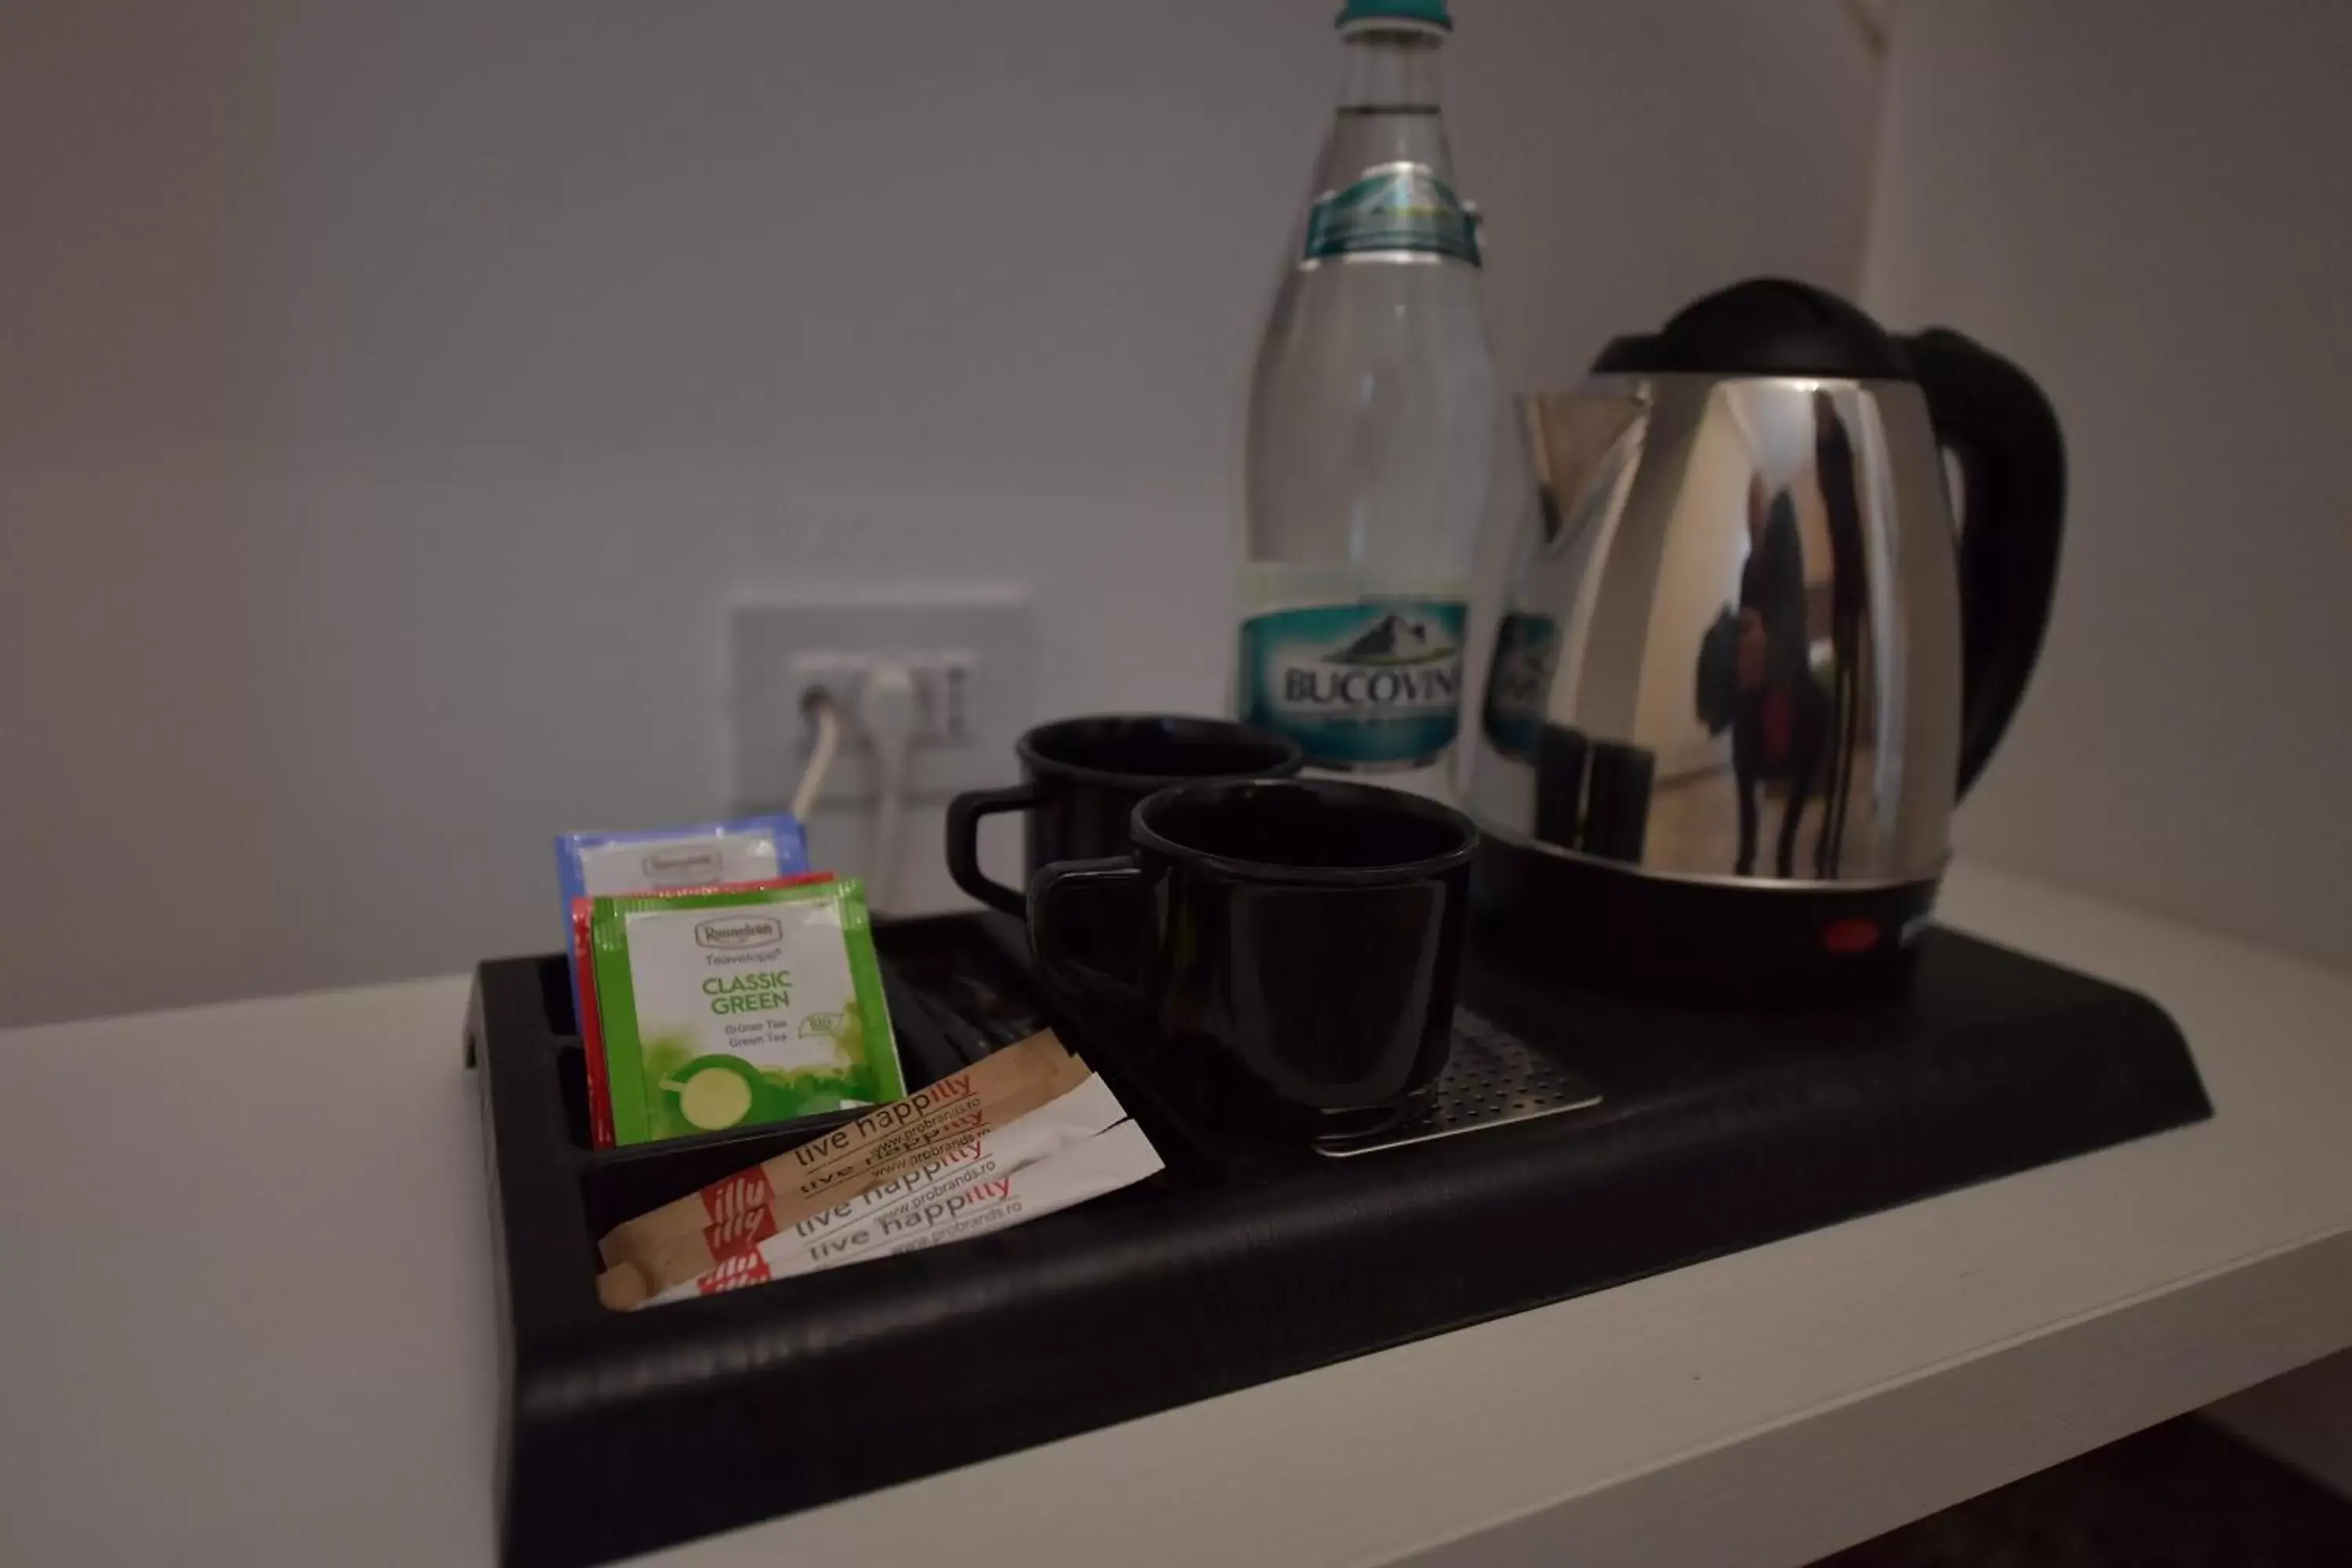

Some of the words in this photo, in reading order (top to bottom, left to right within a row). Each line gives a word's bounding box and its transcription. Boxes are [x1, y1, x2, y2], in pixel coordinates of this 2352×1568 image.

[702, 970, 792, 996] CLASSIC
[711, 990, 790, 1015] GREEN
[796, 1131, 849, 1167] live
[796, 1202, 852, 1237] live
[810, 1229, 869, 1261] live
[878, 1177, 1010, 1236] happilly
